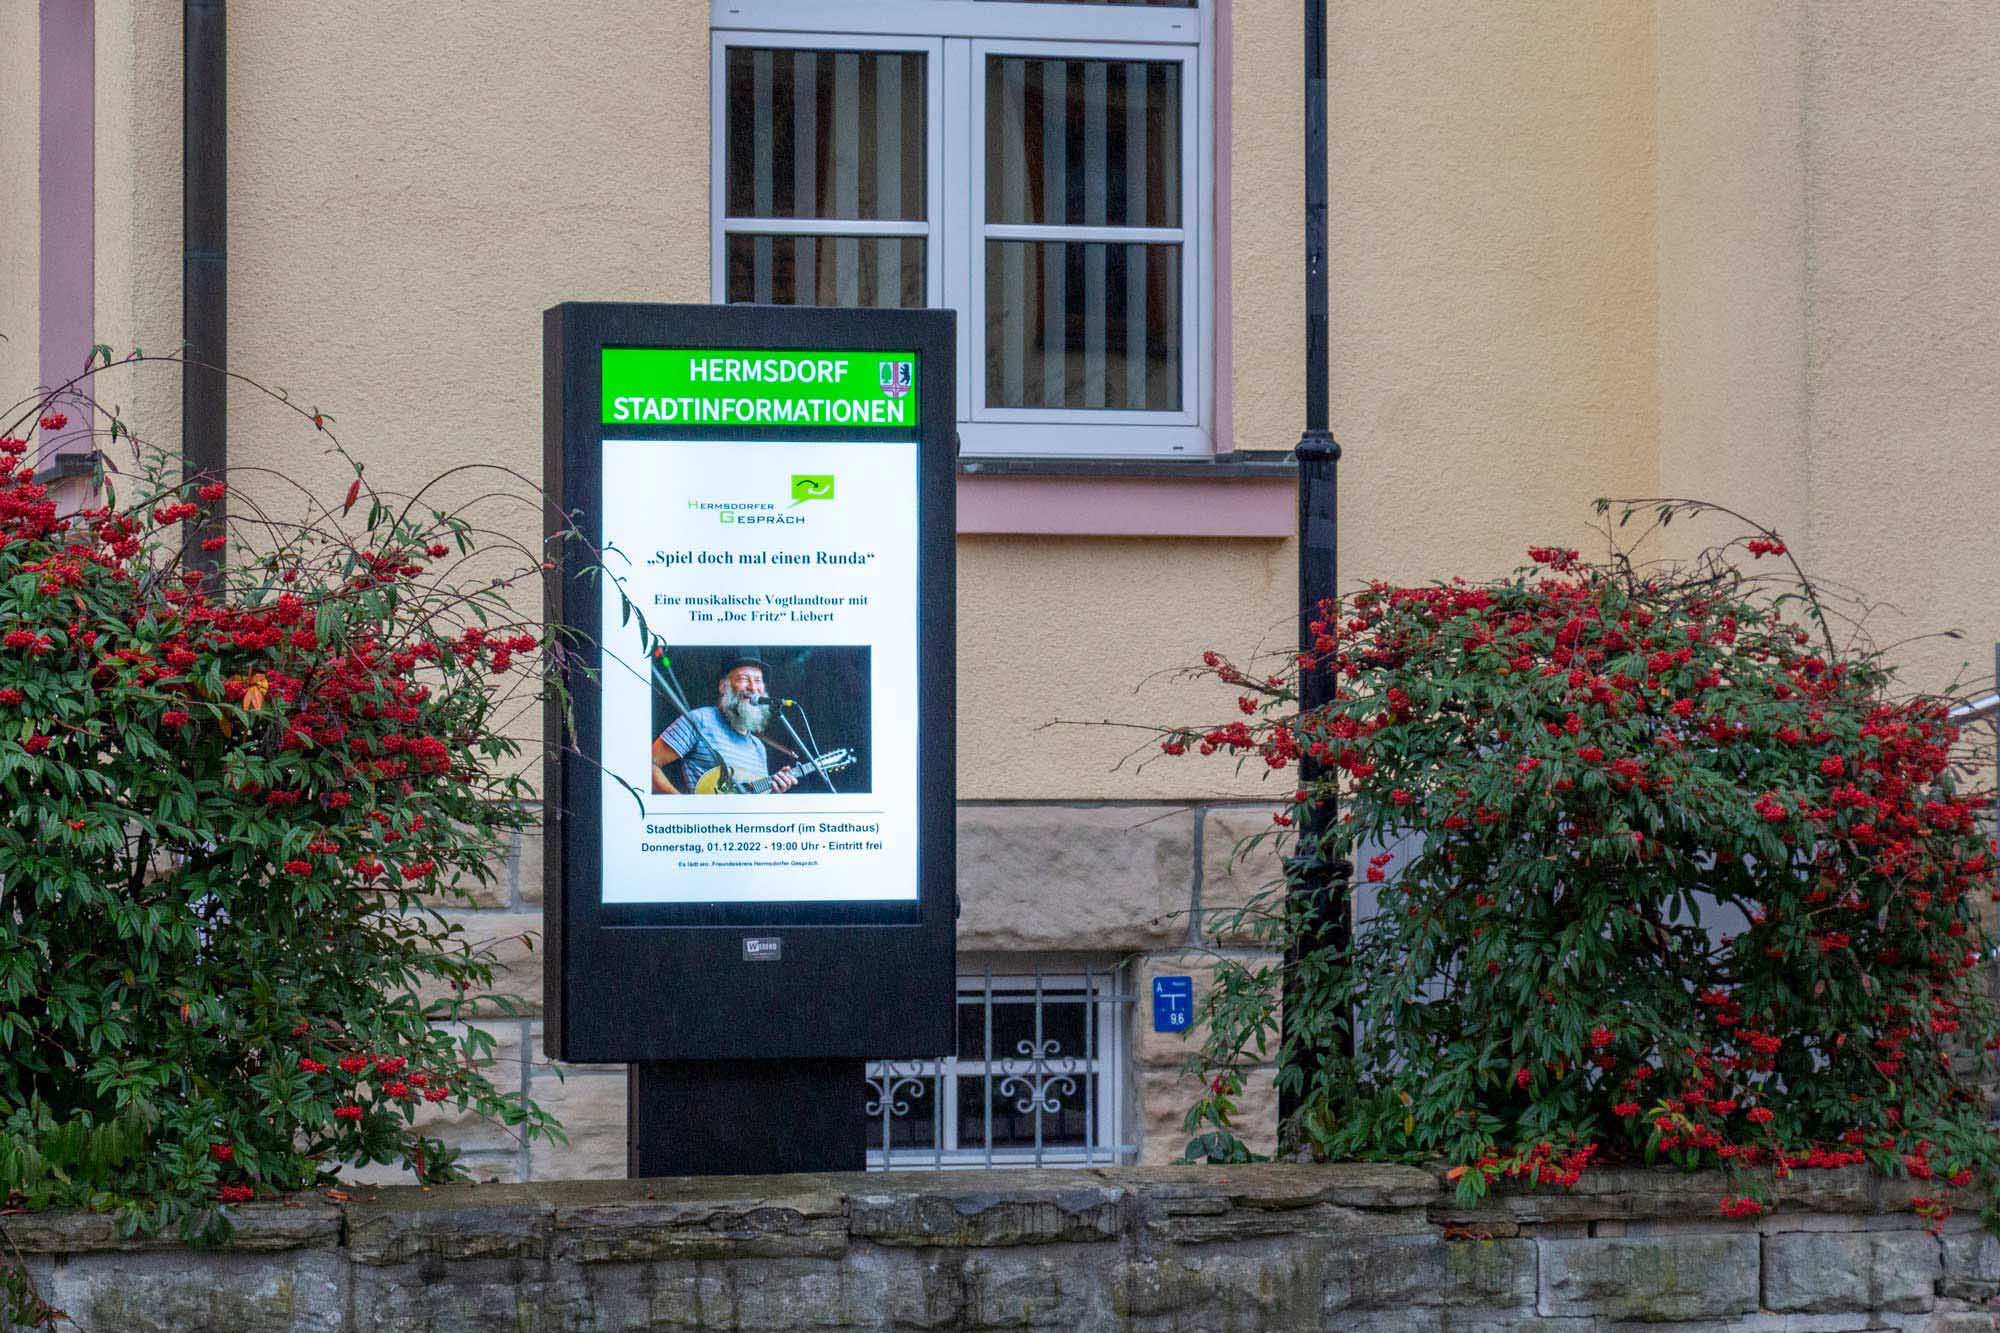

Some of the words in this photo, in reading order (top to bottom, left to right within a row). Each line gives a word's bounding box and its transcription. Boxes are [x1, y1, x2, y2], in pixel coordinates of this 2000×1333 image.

[689, 358, 849, 383] HERMSDORF
[613, 396, 905, 423] STADTINFORMATIONEN
[687, 499, 775, 511] HERMSDORFER
[719, 510, 806, 525] GESPRÄCH
[697, 550, 734, 565] doch
[739, 551, 767, 565] mal
[771, 551, 811, 565] einen
[654, 594, 681, 605] Eine
[685, 594, 762, 606] musikalische
[765, 594, 846, 608] Vogtlandtour
[848, 594, 868, 606] mit
[688, 610, 713, 622] Tim
[790, 610, 835, 622] Liebert
[646, 823, 732, 835] Stadtbibliothek
[735, 823, 796, 834] Hermsdorf
[798, 823, 816, 836] (im
[819, 822, 880, 835] Stadthaus)
[641, 842, 705, 854] Donnerstag,
[706, 841, 762, 852] 01.12.2022
[771, 841, 798, 852] 19:00
[800, 841, 820, 851] Uhr
[828, 840, 863, 851] Eintritt
[865, 840, 883, 851] frei
[1156, 981, 1163, 992] A
